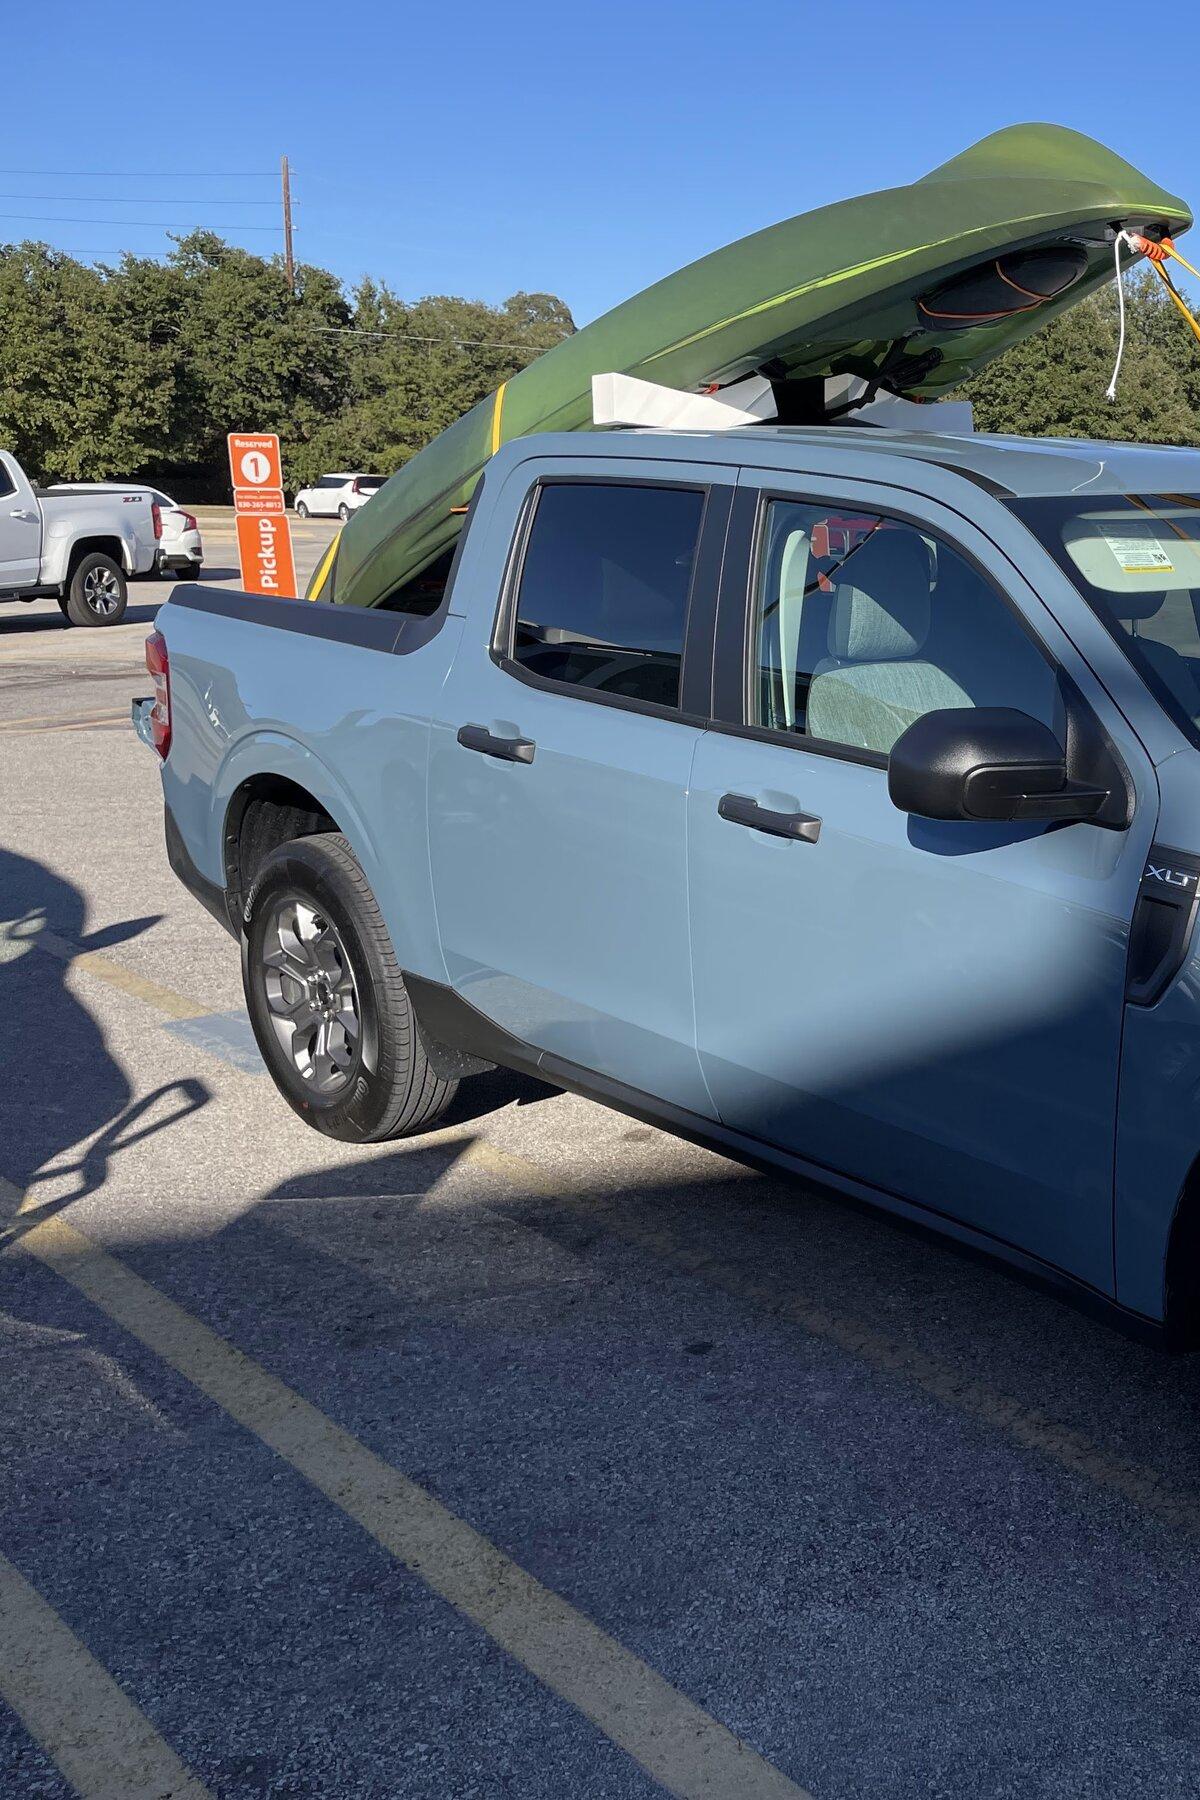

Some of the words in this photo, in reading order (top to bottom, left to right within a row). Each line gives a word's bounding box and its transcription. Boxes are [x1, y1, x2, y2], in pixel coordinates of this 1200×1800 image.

[234, 439, 273, 448] Reserved
[250, 457, 260, 477] 1
[257, 518, 279, 589] Pickup
[1145, 864, 1198, 887] XLT
